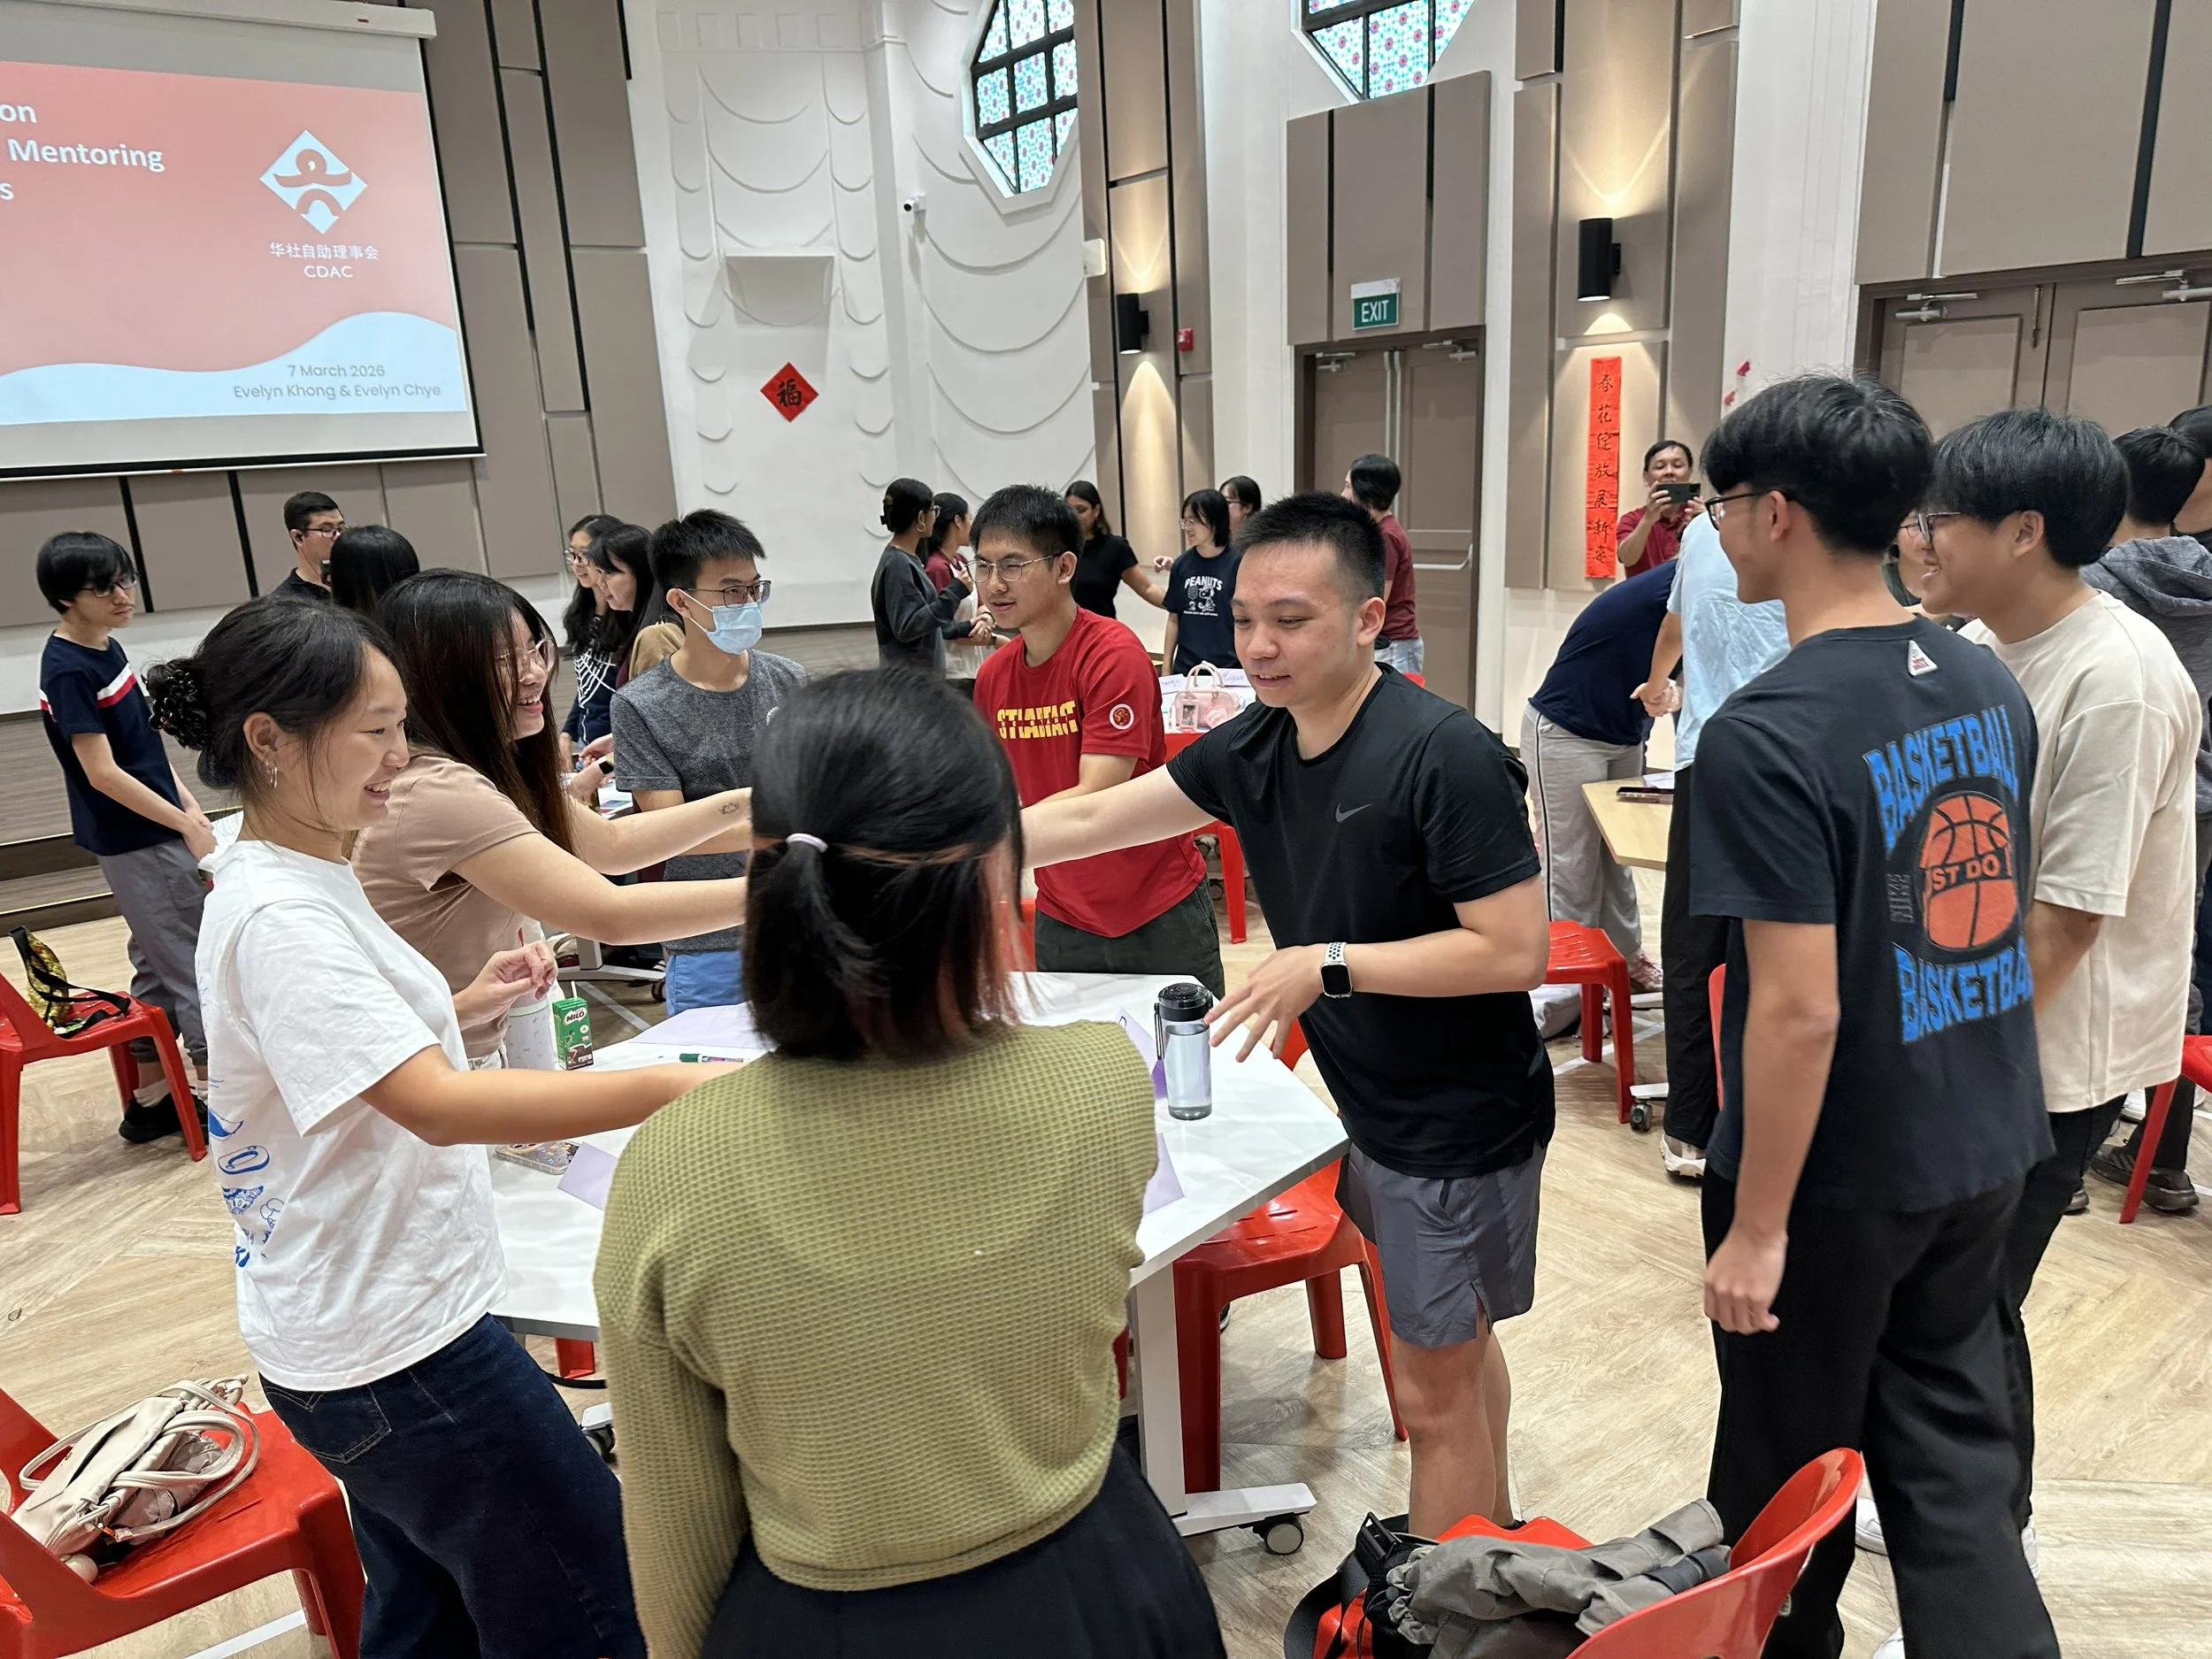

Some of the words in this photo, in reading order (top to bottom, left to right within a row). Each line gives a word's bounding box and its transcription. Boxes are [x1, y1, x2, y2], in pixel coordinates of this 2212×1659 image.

[7, 137, 165, 173] Mentoring
[269, 242, 380, 260] 华社自助理事会
[303, 265, 354, 279] CDAC
[1361, 299, 1389, 323] EXIT
[288, 365, 297, 377] 7
[300, 364, 348, 378] March
[350, 365, 386, 378] 2026
[233, 384, 284, 401] Evelyn
[287, 383, 336, 400] Khong
[339, 384, 351, 397] &
[355, 384, 400, 400] Evelyn
[403, 382, 442, 400] Chye
[777, 378, 803, 407] 福
[1184, 575, 1223, 591] PEANUTS
[1863, 705, 2018, 854] BASKETBALL
[1965, 854, 2001, 879] DO
[1892, 934, 2034, 1043] BASKETBA
[566, 1011, 585, 1022] MILO
